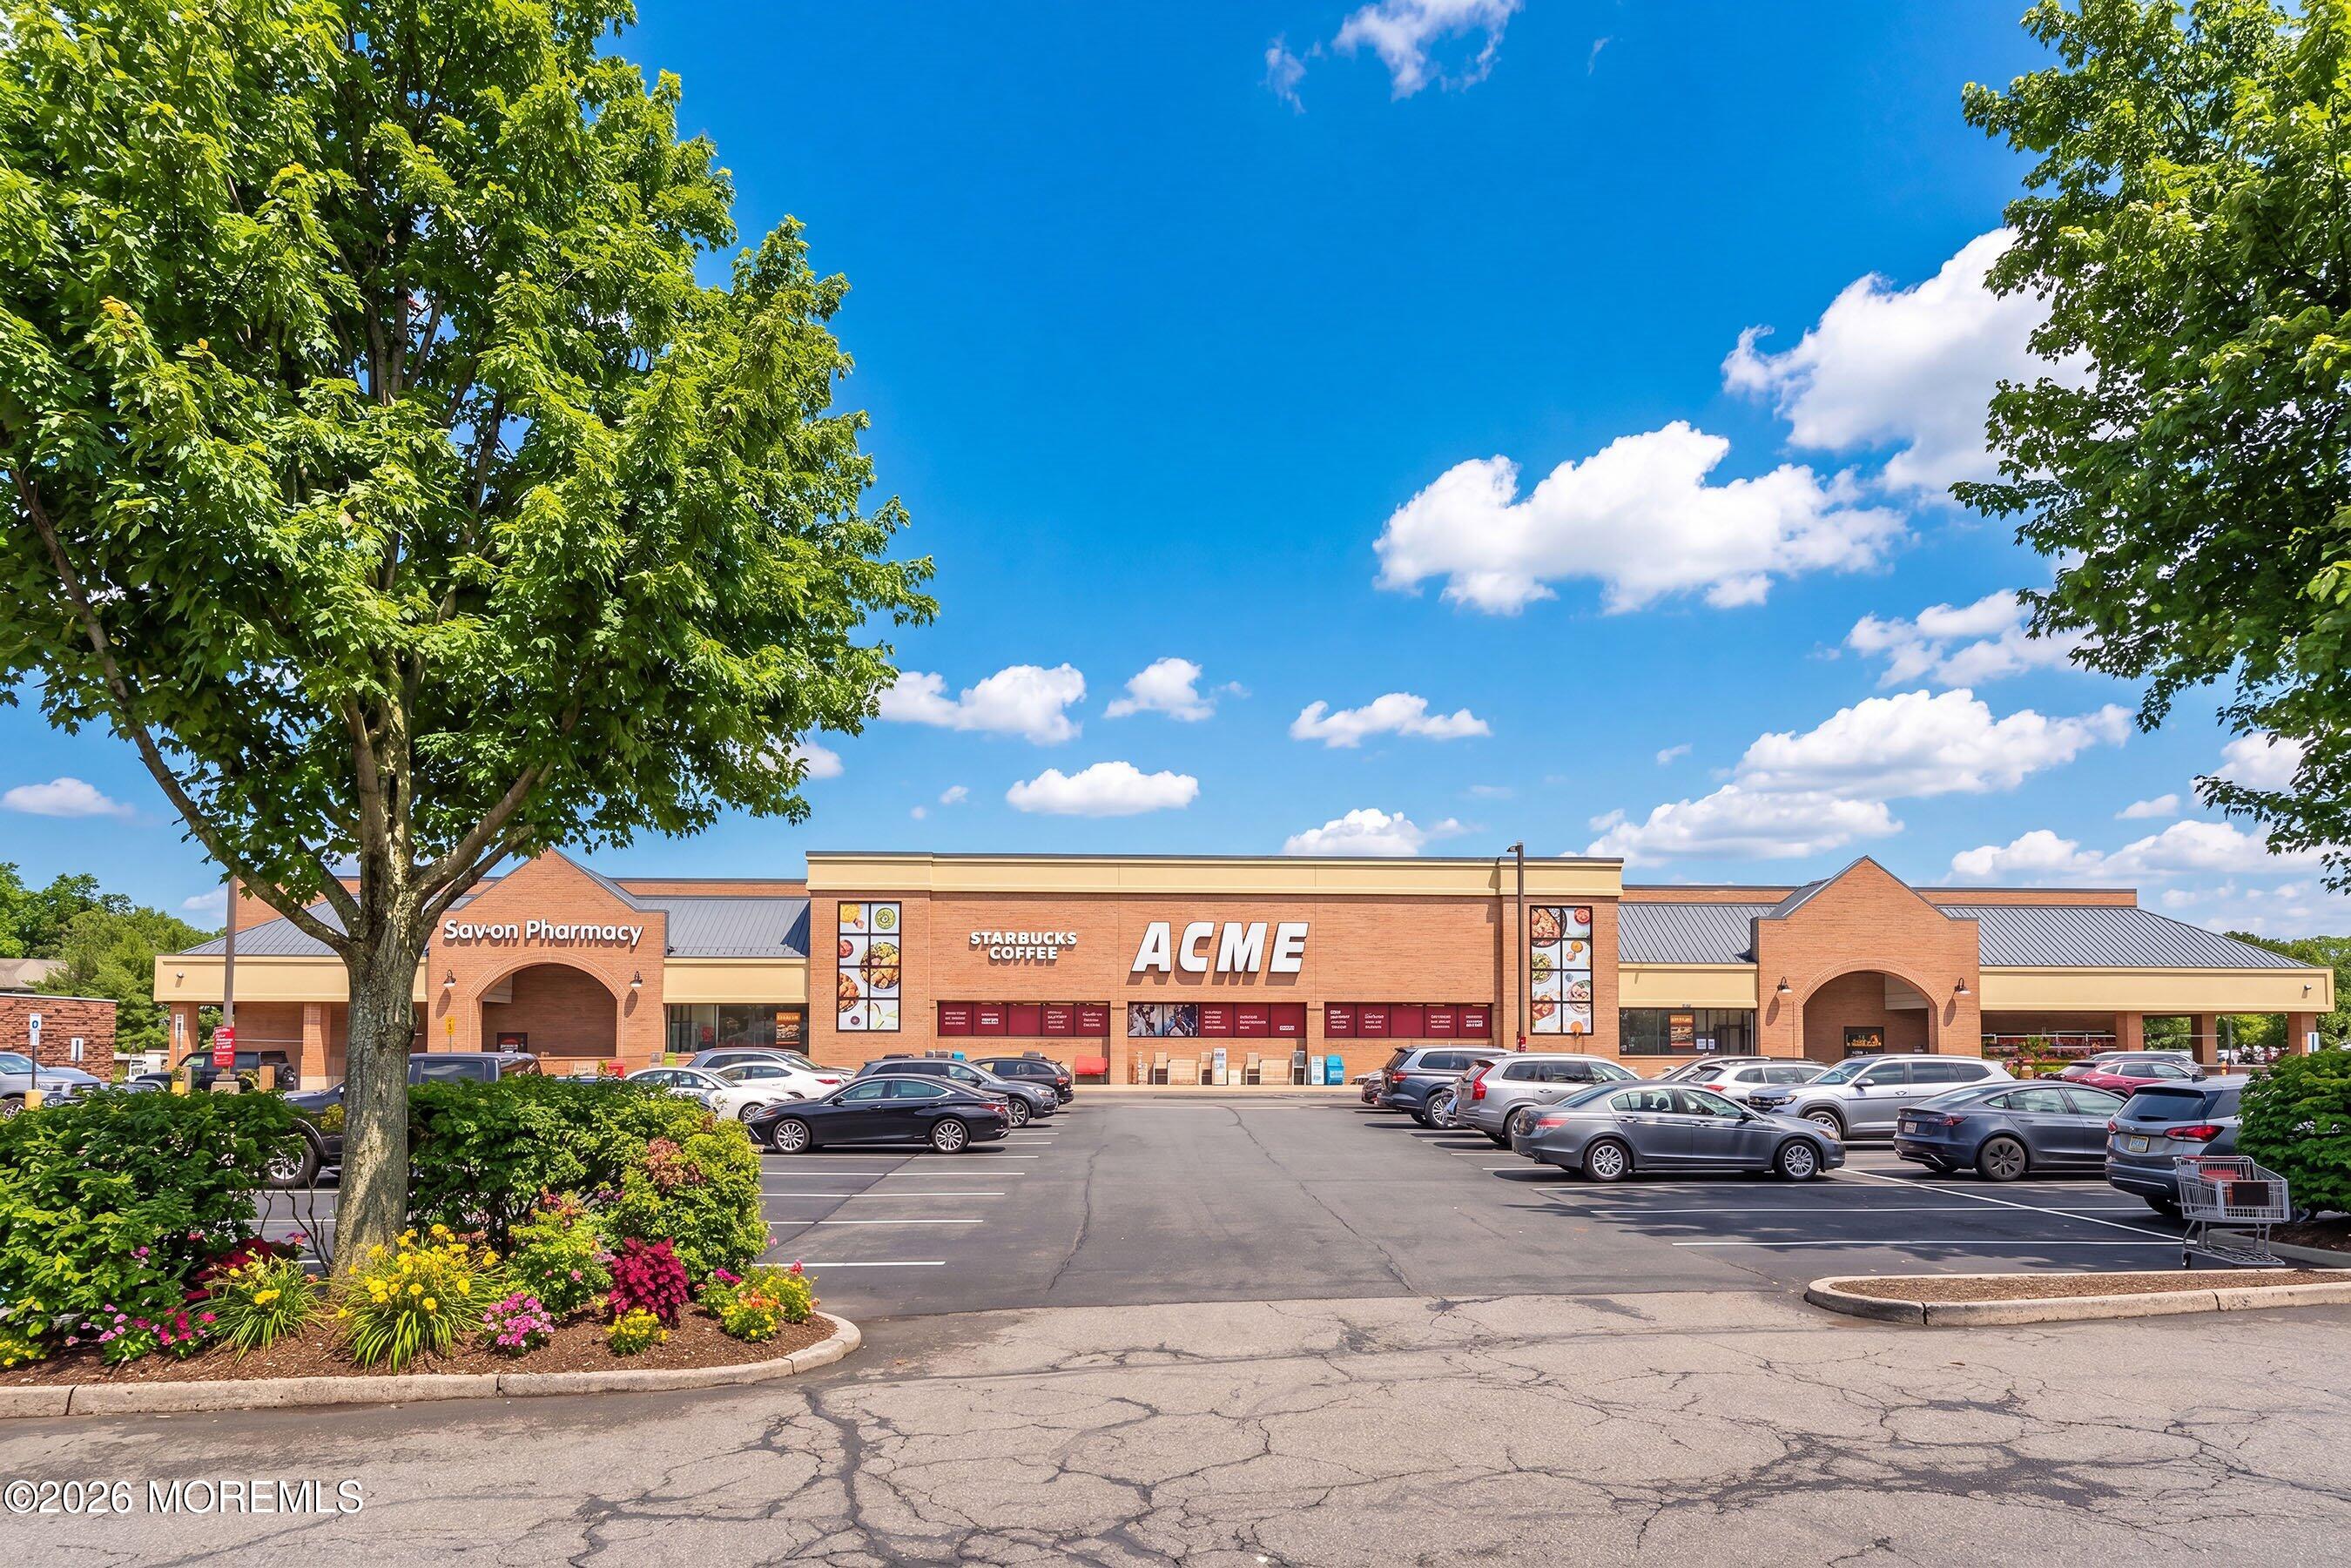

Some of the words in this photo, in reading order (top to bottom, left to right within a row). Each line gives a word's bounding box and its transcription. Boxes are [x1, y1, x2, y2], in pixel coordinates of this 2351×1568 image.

[443, 919, 520, 940] Sav-on
[525, 919, 644, 946] Pharmacy
[969, 931, 1078, 946] STARBUCKS
[988, 946, 1058, 960] COFFEE
[1130, 920, 1310, 973] ACME
